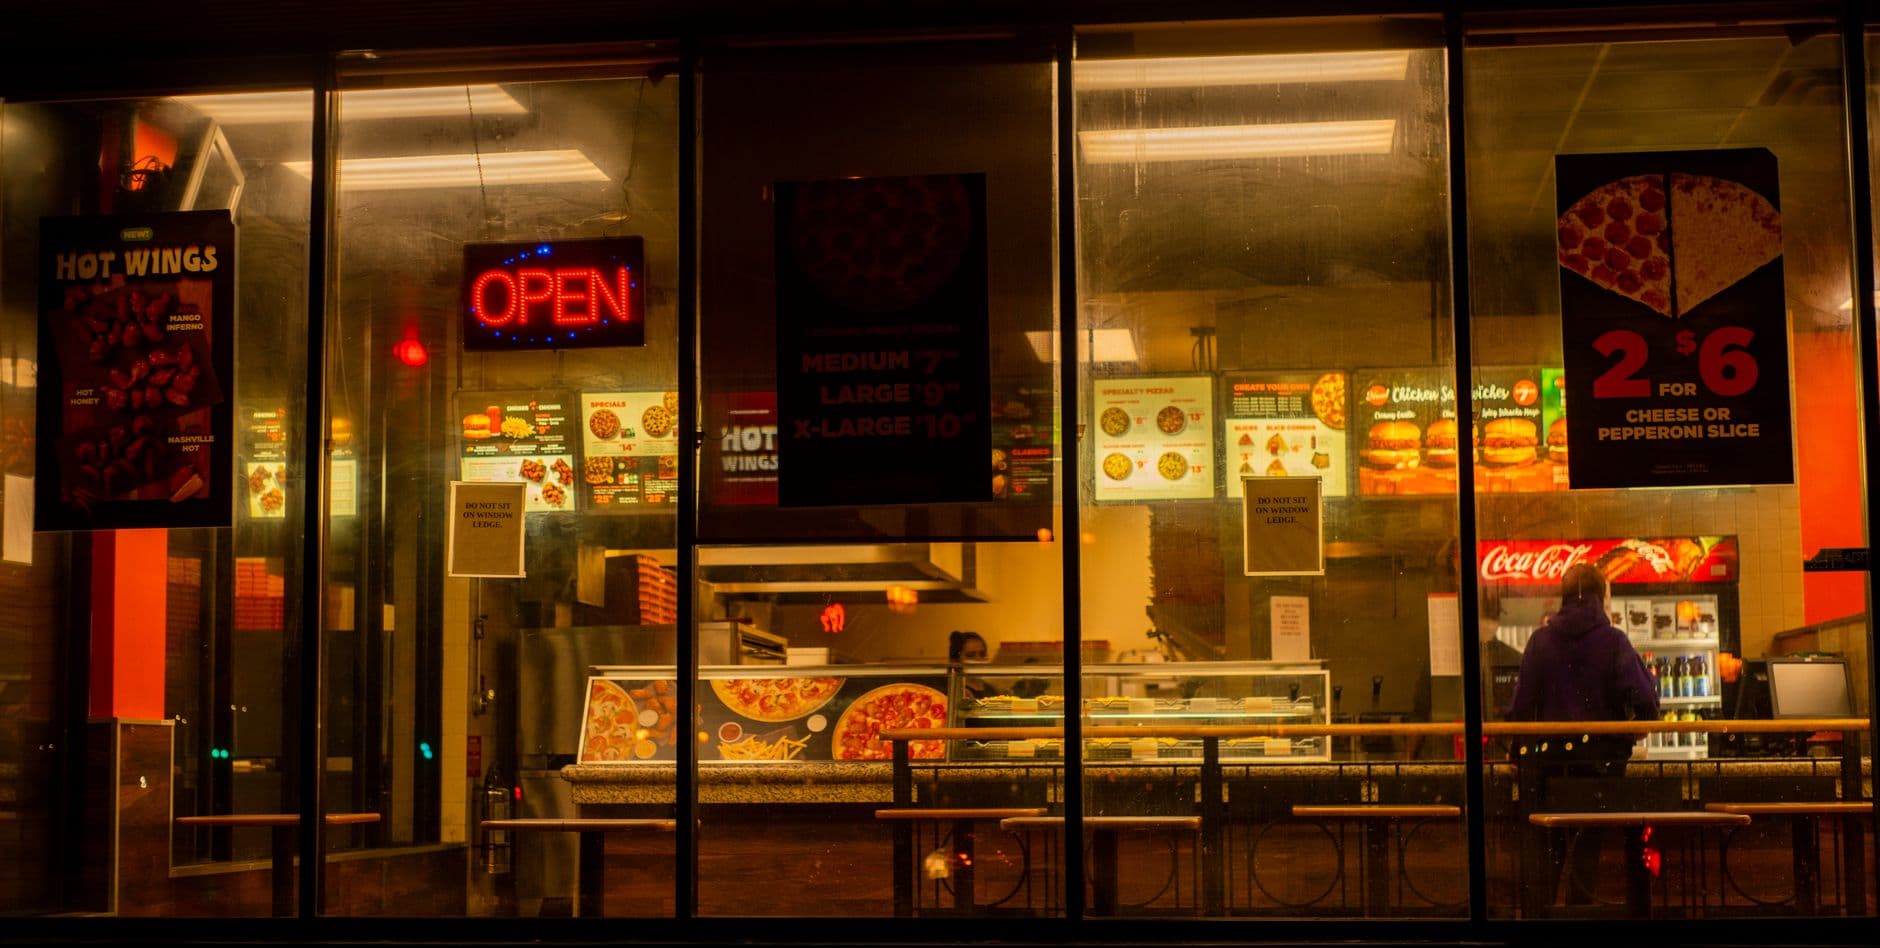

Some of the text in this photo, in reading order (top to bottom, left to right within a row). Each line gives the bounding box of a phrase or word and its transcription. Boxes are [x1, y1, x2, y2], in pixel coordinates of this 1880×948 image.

[56, 246, 218, 281] HOT WINGS
[471, 266, 631, 326] OPEN
[167, 323, 204, 331] INFERNO
[169, 314, 201, 322] MANGO
[801, 351, 910, 373] MEDIUM
[1591, 329, 1651, 399] 2
[1659, 383, 1697, 397] FOR
[70, 397, 100, 406] HONEY
[76, 389, 94, 397] HOT
[820, 383, 911, 405] LARGE
[1392, 385, 1439, 403] Chicken
[1626, 407, 1731, 423] CHEESE OR
[794, 415, 912, 439] X-LARGE
[1598, 423, 1760, 441] PEPPERONI SLICE
[168, 435, 215, 444] NASHVILLE
[721, 424, 778, 452] HOT
[721, 455, 779, 472] WINGS
[463, 511, 512, 519] ON WINDOW
[1481, 544, 1593, 580] Coca-Col
